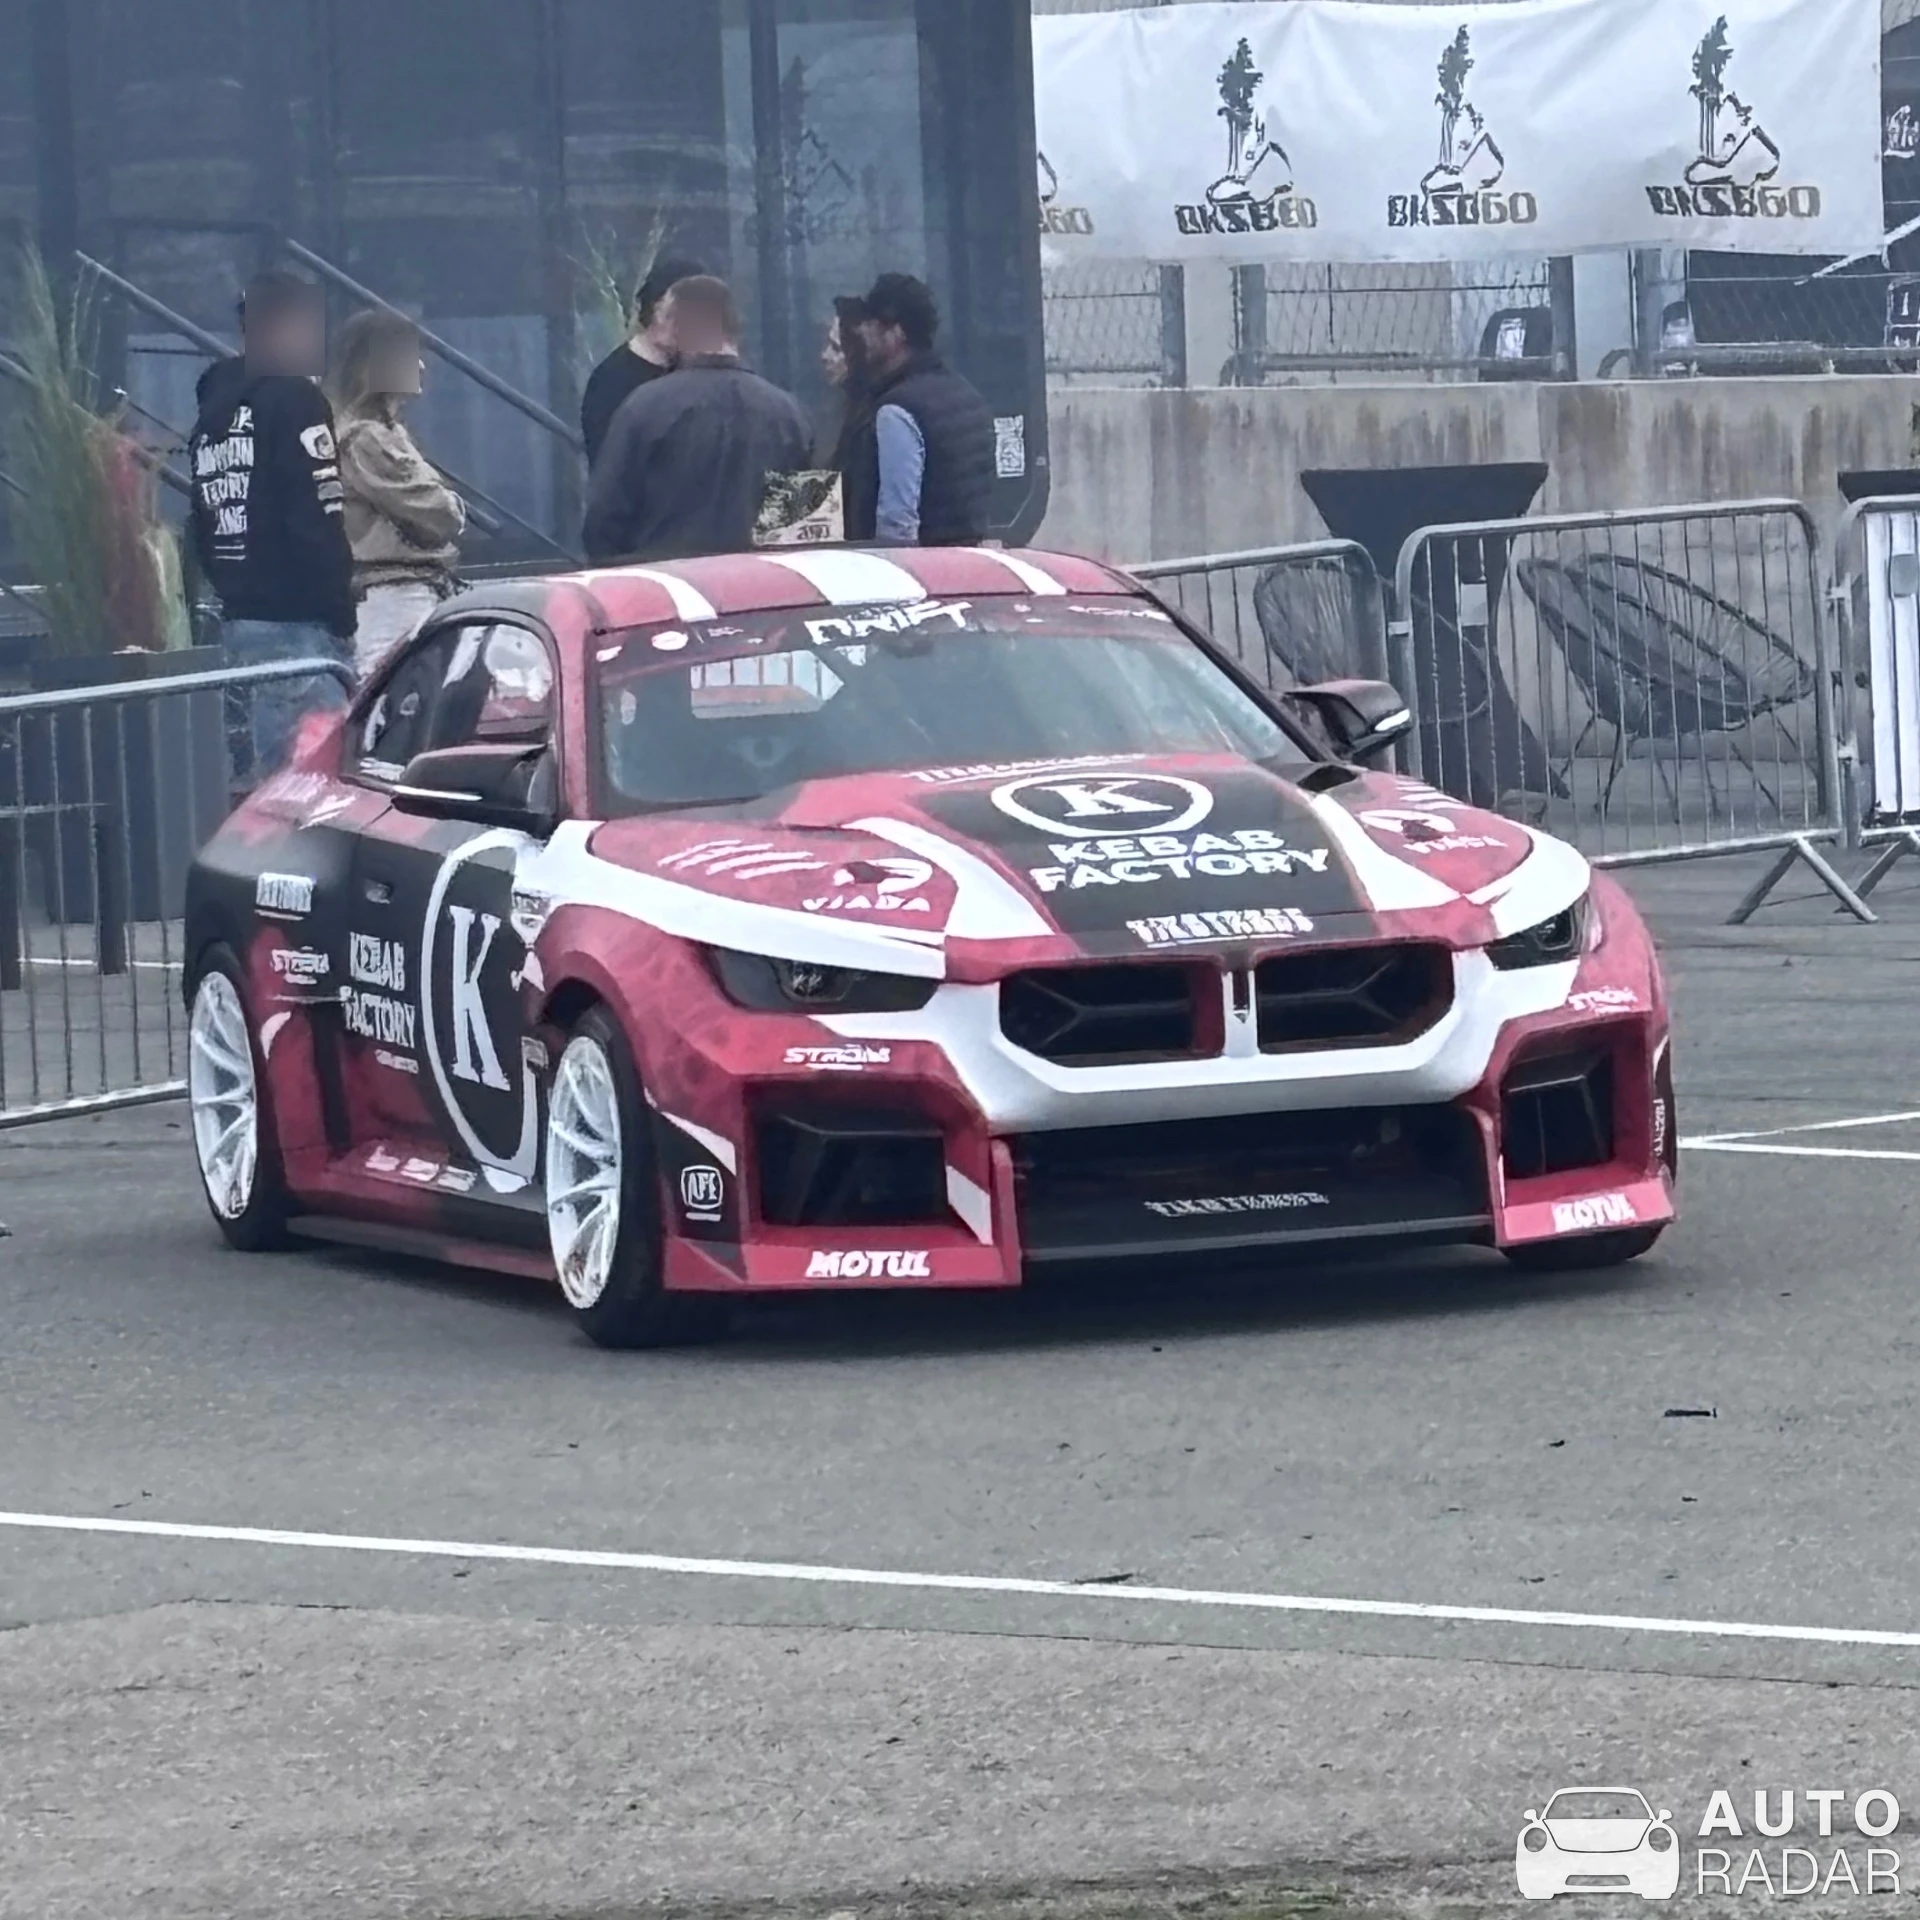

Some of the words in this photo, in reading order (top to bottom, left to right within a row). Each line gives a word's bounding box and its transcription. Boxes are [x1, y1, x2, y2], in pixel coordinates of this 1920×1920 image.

[1034, 780, 1174, 817] K
[1048, 829, 1284, 864] KEBAB
[1030, 849, 1328, 892] FACTORY
[449, 905, 511, 1091] K
[806, 1251, 930, 1277] MOTUL
